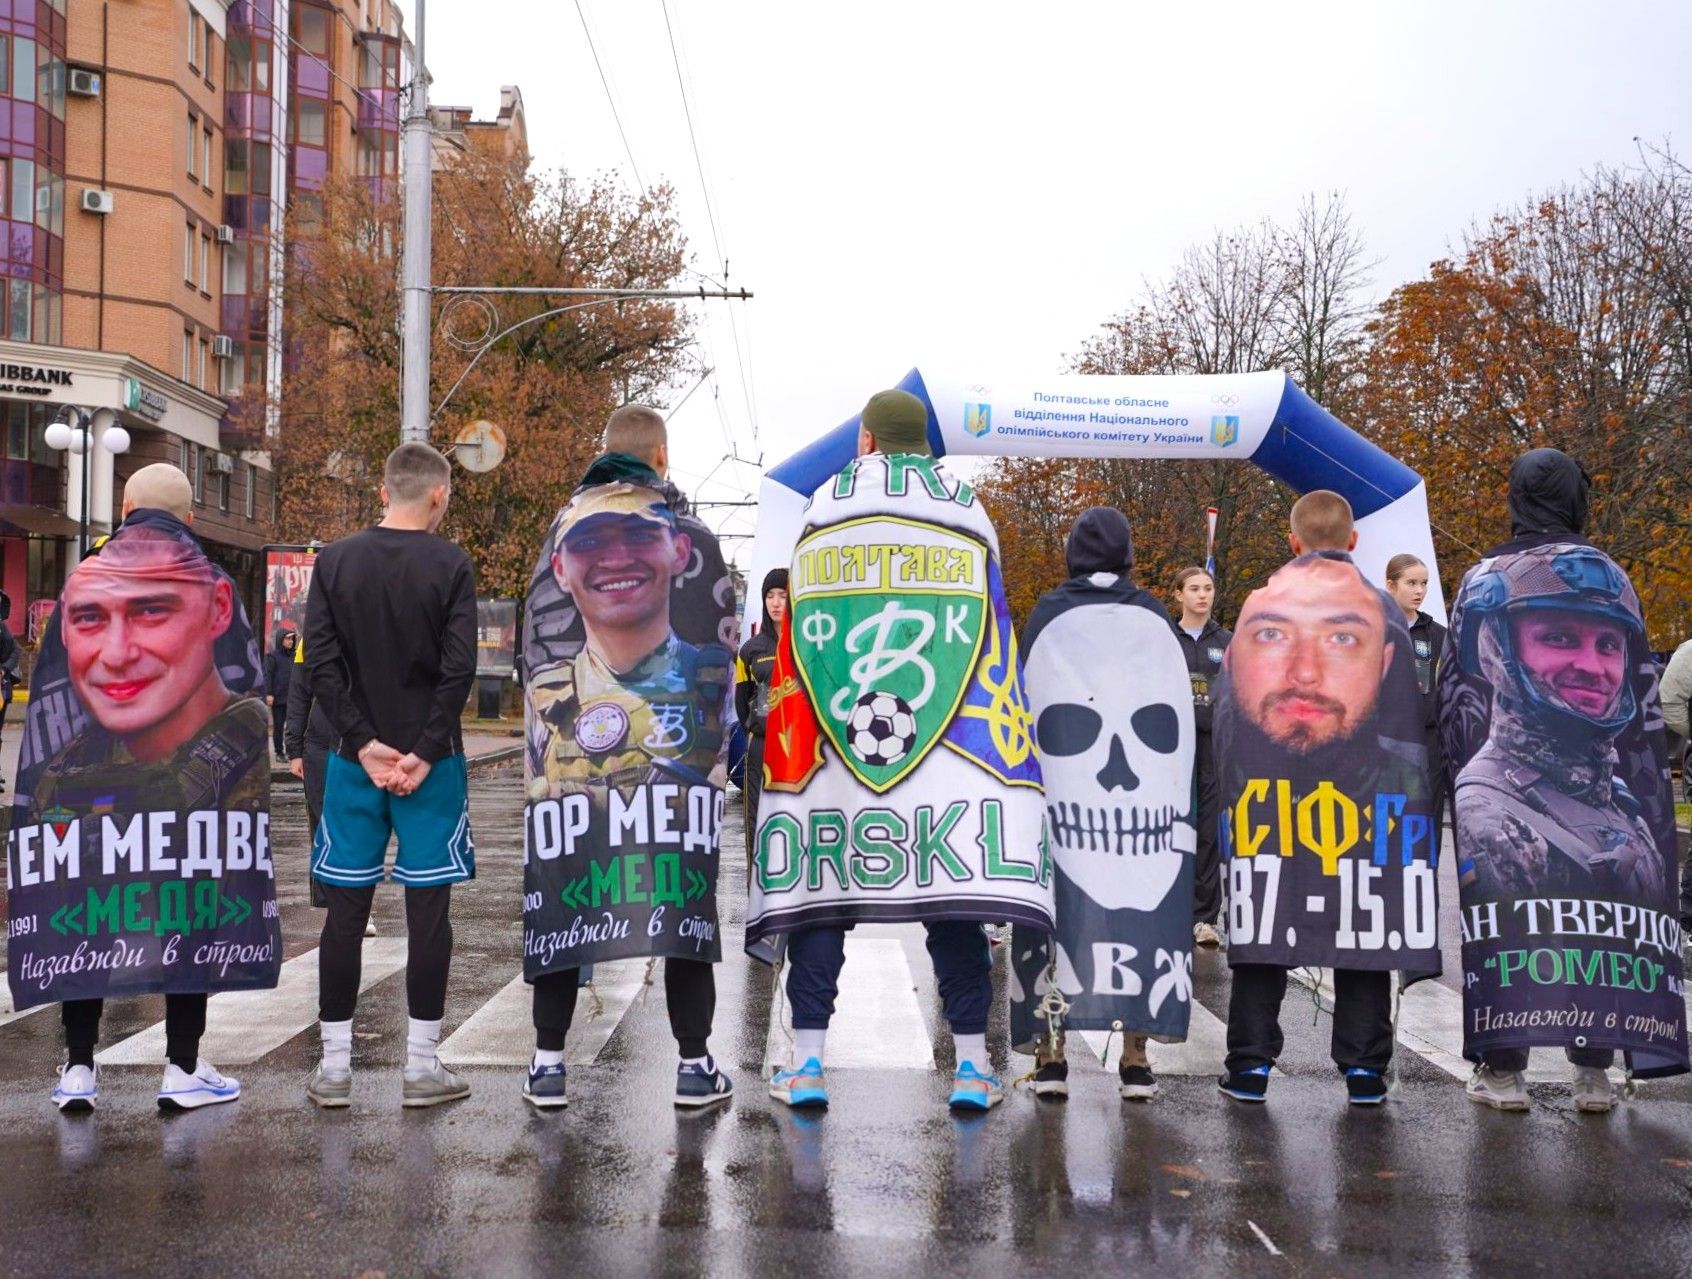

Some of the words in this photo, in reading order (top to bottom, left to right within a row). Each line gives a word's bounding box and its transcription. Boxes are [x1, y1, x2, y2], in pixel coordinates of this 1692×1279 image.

[1013, 408, 1086, 424] відділення
[1089, 411, 1189, 428] Національного
[1033, 392, 1110, 408] Полтавське
[1114, 396, 1169, 408] обласне
[997, 424, 1090, 440] олімпійського
[1093, 432, 1150, 445] комітету
[1153, 430, 1204, 444] України
[798, 544, 975, 585] ПОЛТАВА
[802, 610, 837, 650] Ф
[102, 810, 274, 878] МЕДВЕ
[523, 912, 632, 965] Назавжди
[647, 906, 666, 936] в
[21, 940, 147, 990] Назавжди
[162, 934, 182, 965] в
[194, 934, 273, 977] строю!
[1473, 1003, 1595, 1034] Назавжди
[1605, 1013, 1617, 1028] в
[1625, 1013, 1680, 1042] строю!
